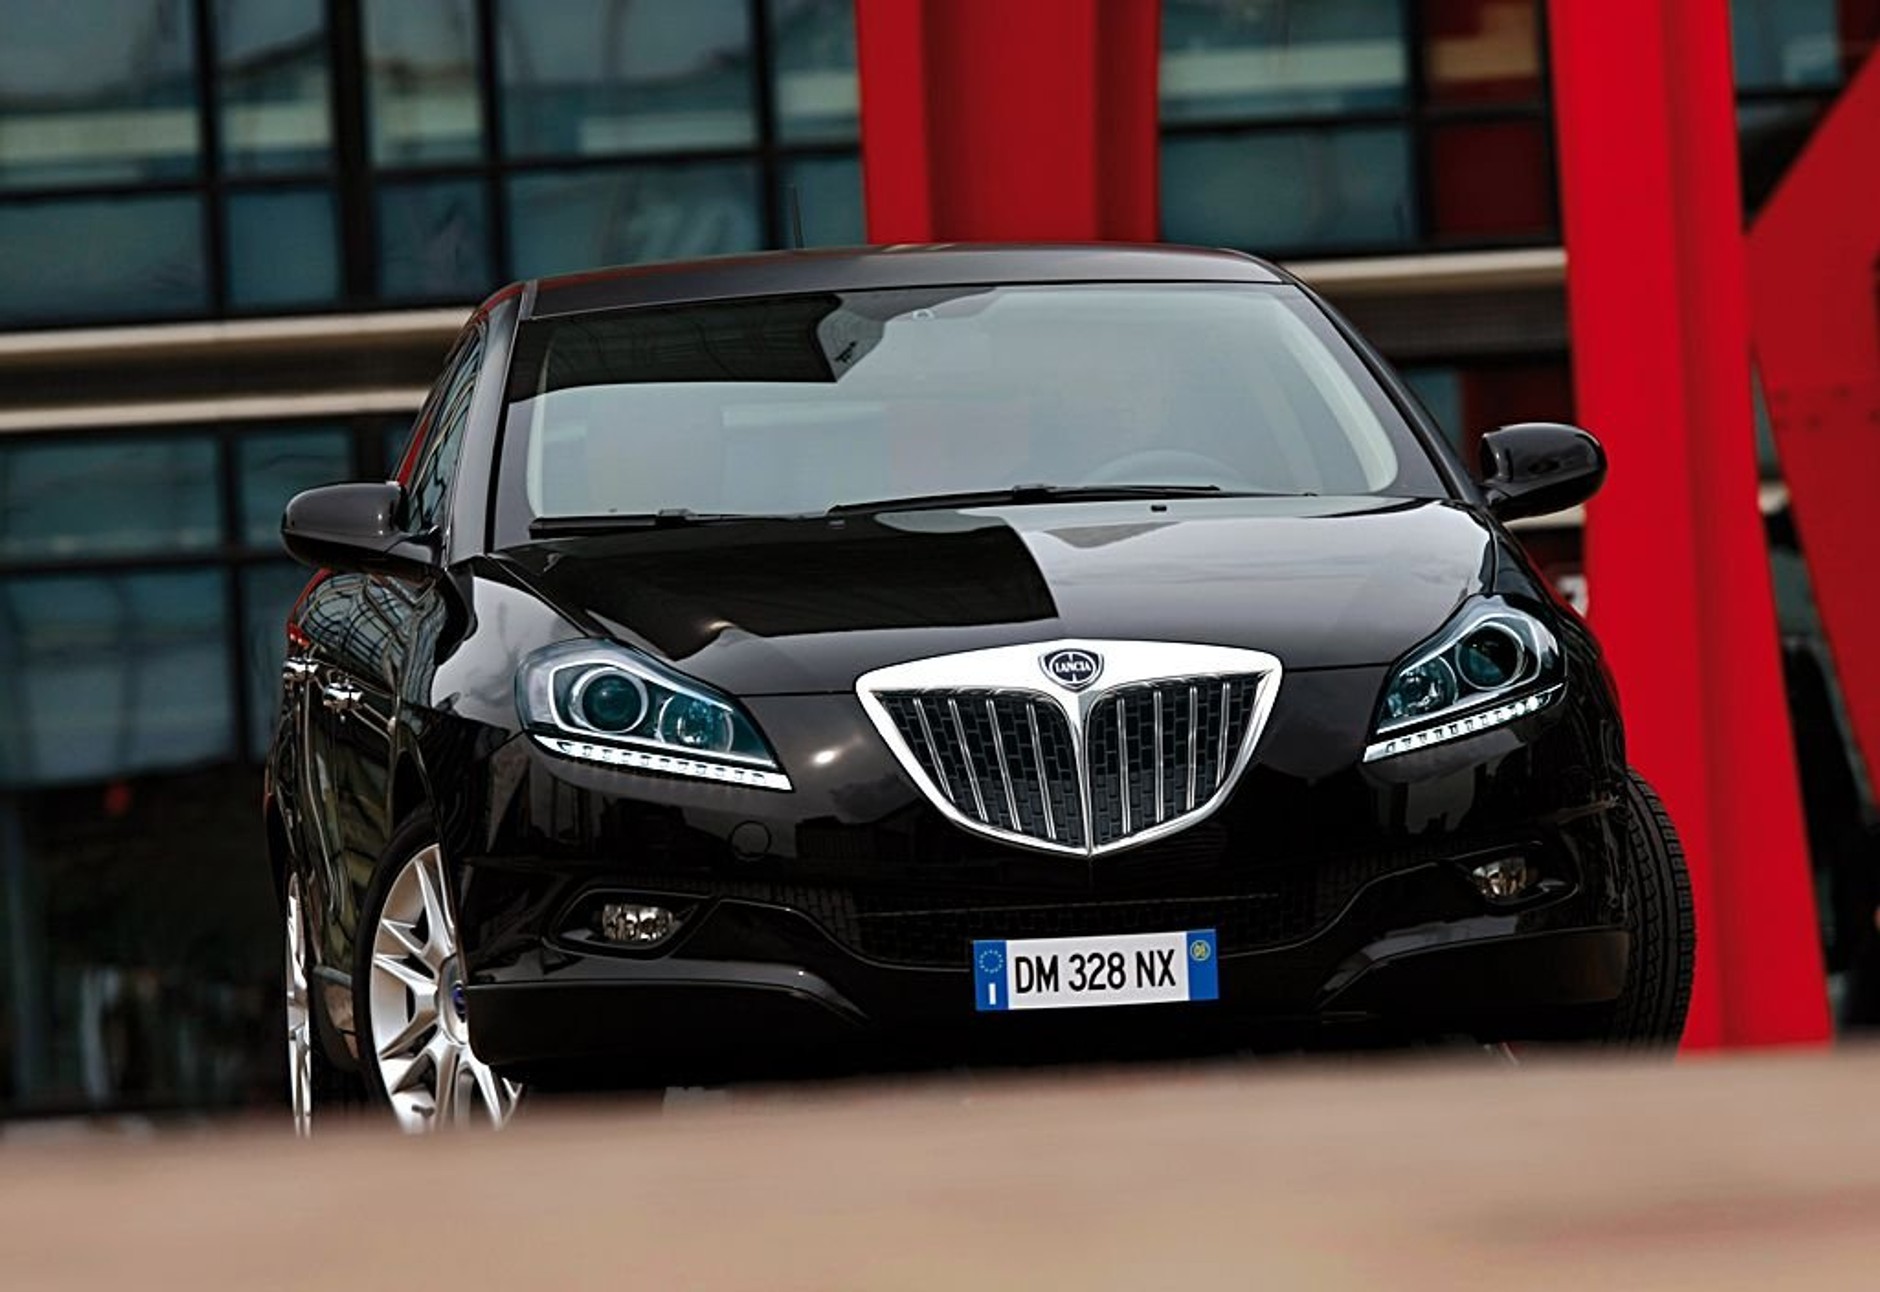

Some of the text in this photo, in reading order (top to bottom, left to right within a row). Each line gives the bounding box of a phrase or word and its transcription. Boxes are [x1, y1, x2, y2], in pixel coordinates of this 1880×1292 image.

[1055, 660, 1092, 673] LANCIA
[1014, 948, 1176, 994] DM 328 NX
